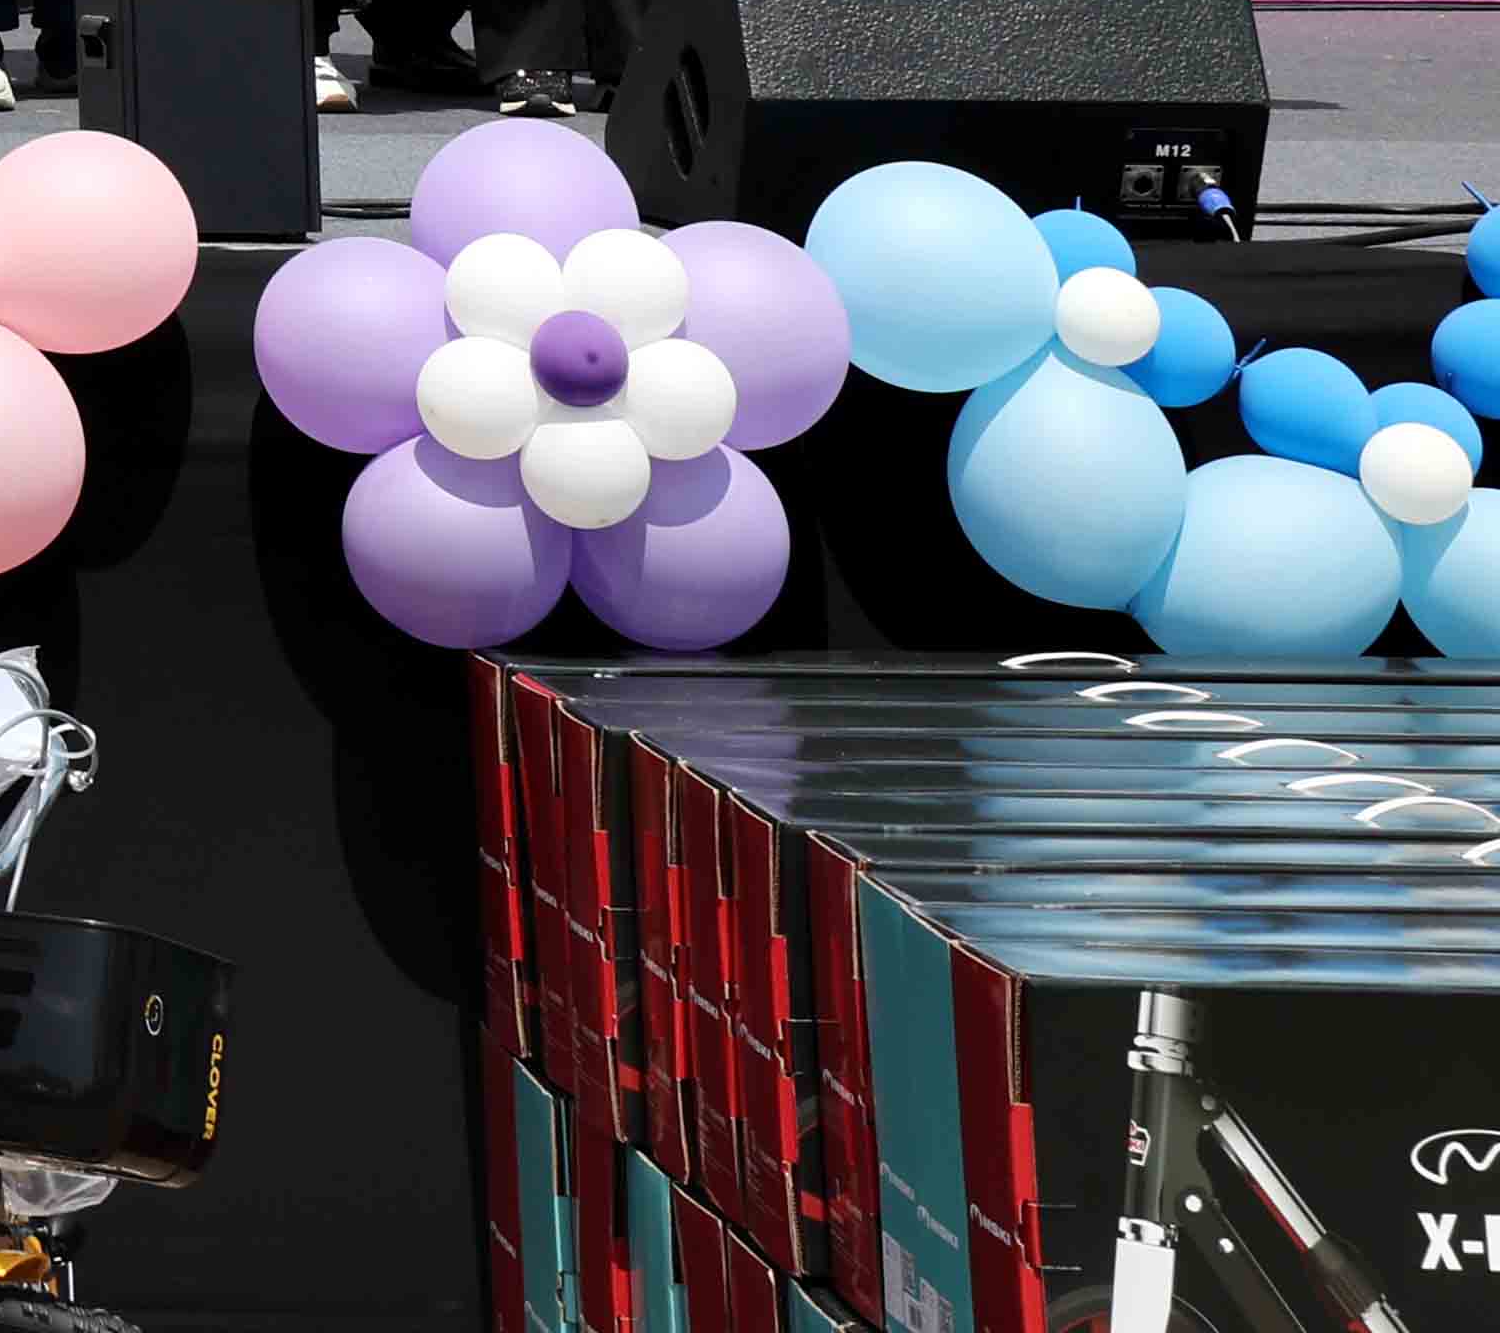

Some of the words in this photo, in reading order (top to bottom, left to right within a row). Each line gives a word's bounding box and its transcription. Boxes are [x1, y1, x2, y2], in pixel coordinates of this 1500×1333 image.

[1155, 144, 1191, 158] M12
[202, 1033, 224, 1141] CLOVER
[1416, 1211, 1500, 1272] X-
